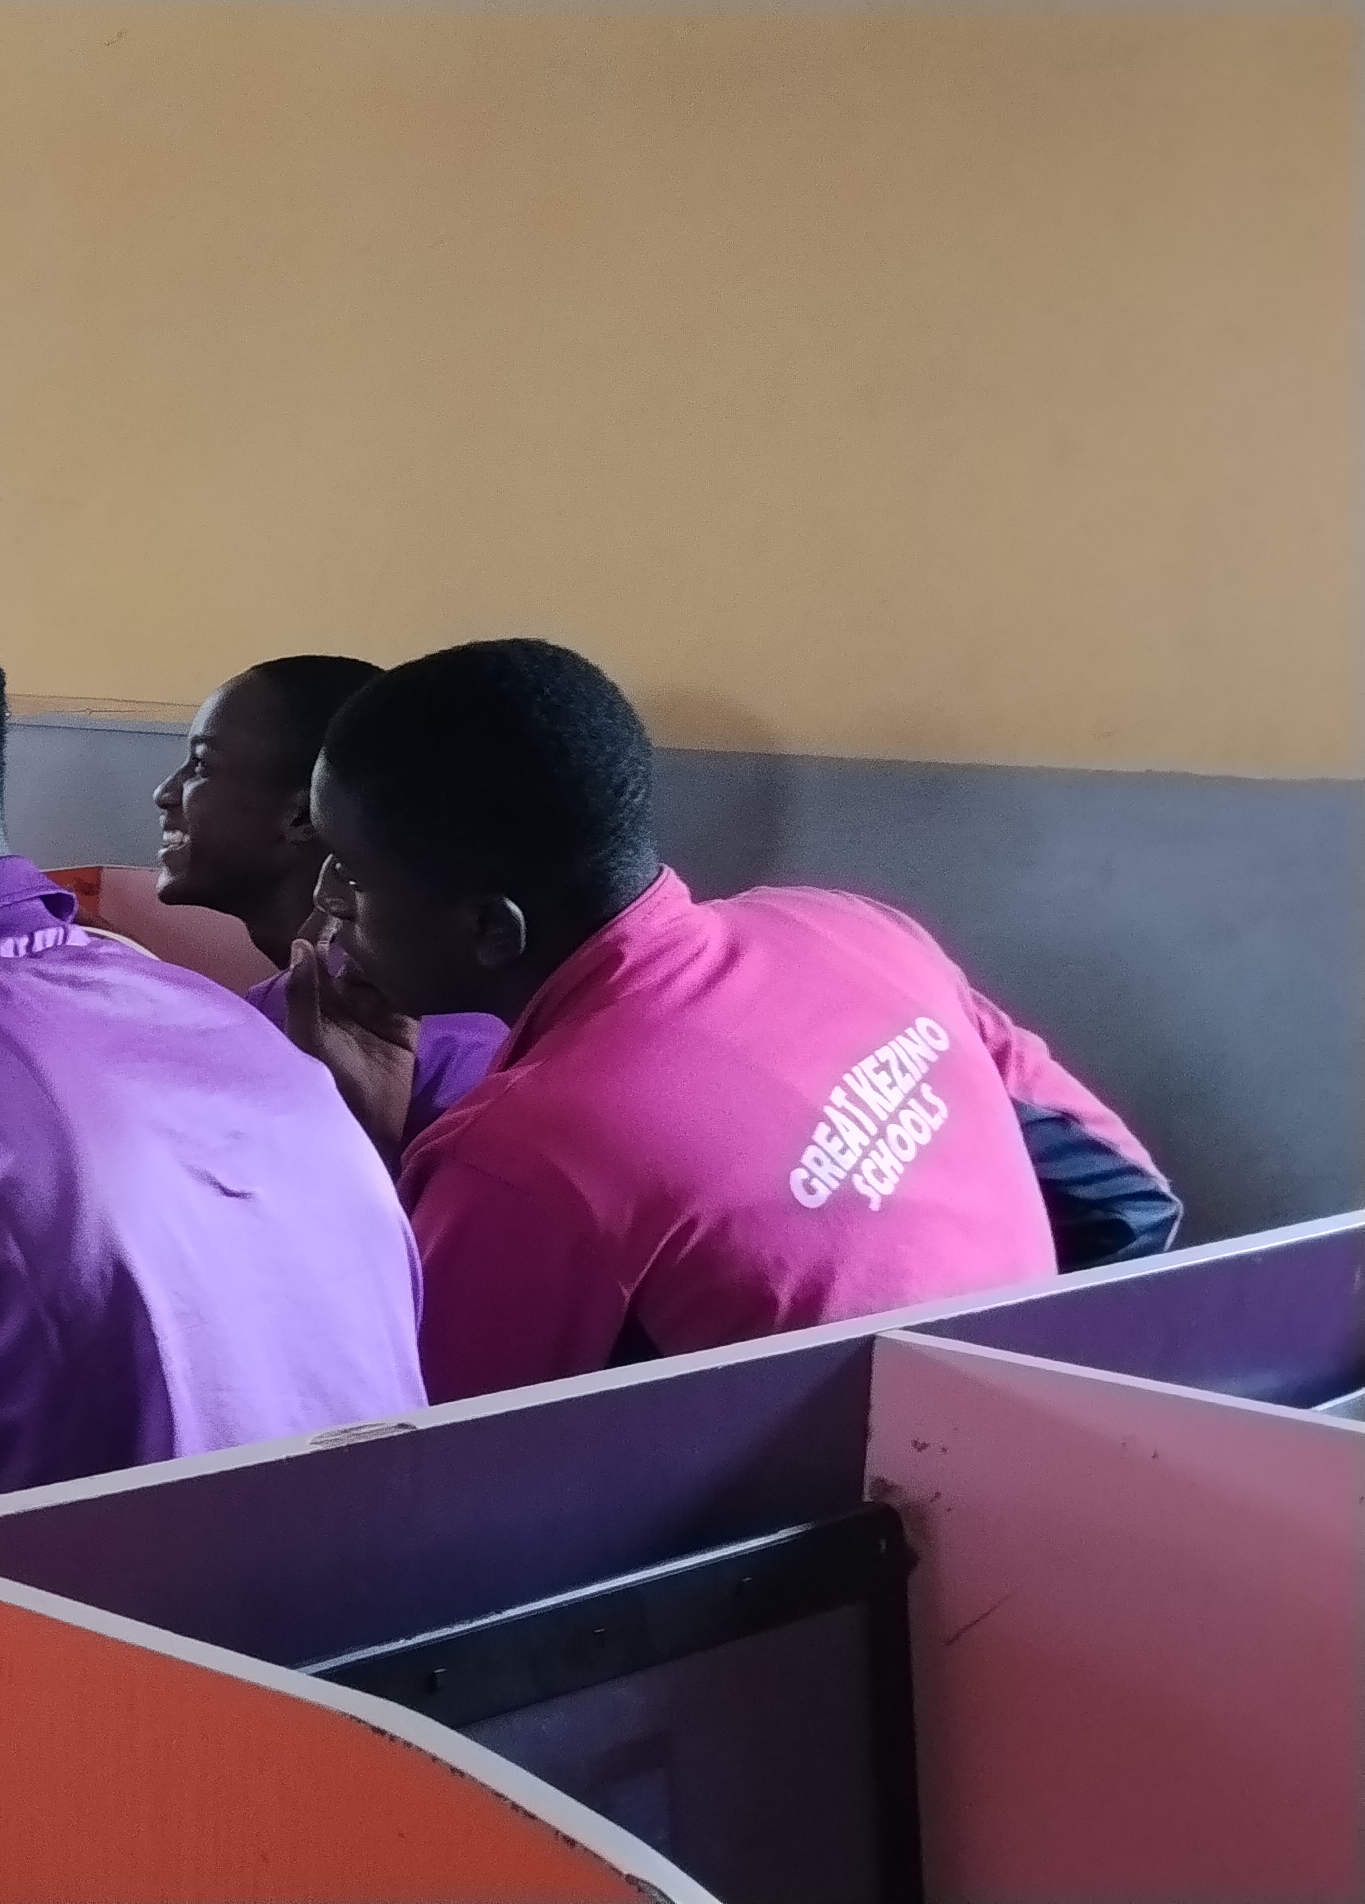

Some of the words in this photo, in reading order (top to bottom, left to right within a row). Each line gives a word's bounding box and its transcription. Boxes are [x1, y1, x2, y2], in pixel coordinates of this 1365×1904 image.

[790, 1086, 878, 1208] GREAT
[842, 1017, 950, 1121] KEZINO
[852, 1083, 949, 1211] SCHOOLS
